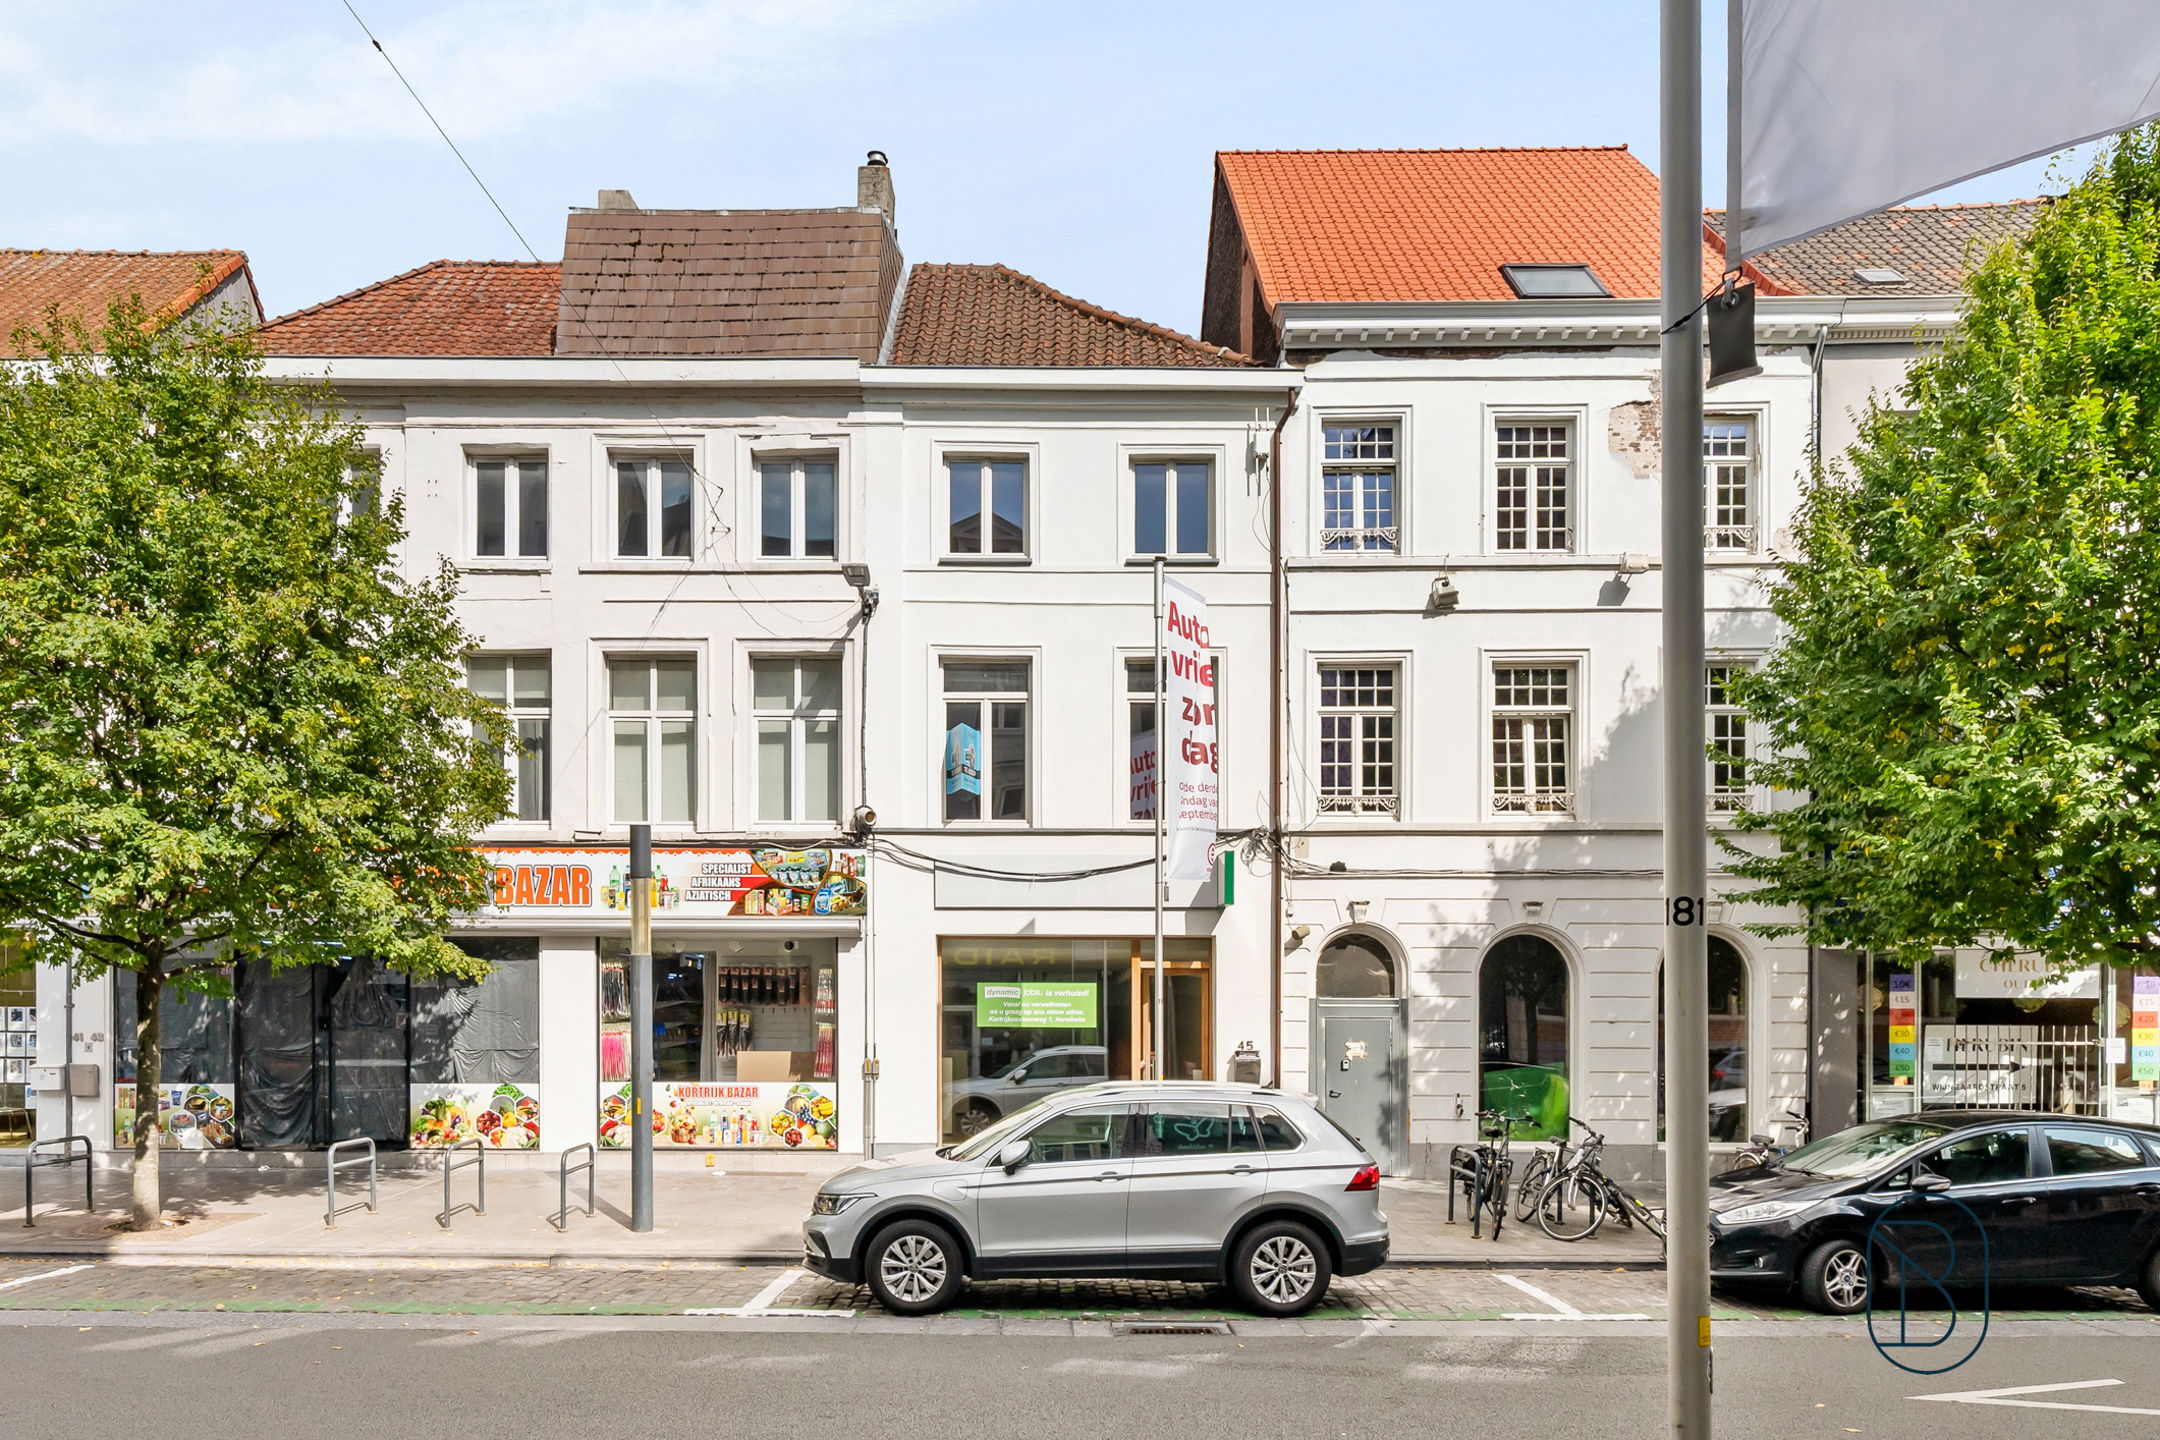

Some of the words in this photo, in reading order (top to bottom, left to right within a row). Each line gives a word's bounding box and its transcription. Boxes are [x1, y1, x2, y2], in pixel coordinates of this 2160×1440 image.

[1168, 601, 1209, 649] Auto
[1171, 650, 1213, 687] vrie
[1131, 750, 1155, 775] uto
[702, 863, 752, 875] SPECIALIST
[495, 866, 591, 906] BAZAR
[691, 877, 741, 888] AFRIKAANS
[685, 890, 731, 901] AZIATISCH
[1665, 896, 1704, 926] 181
[1980, 958, 2070, 973] CHERUB
[1894, 980, 1911, 989] 10€
[986, 988, 1019, 996] dynamic
[1054, 989, 1090, 997] verhuisd!
[1894, 995, 1910, 1003] €15
[2139, 1014, 2154, 1022] €20
[1895, 1030, 1910, 1038] €30
[1238, 1041, 1254, 1051] 45
[1895, 1047, 1910, 1055] €40
[1946, 1038, 2029, 1053] HERUBIN
[1895, 1064, 1910, 1072] €50
[2139, 1067, 2154, 1075] €50
[678, 1086, 725, 1098] KORTRIJK
[727, 1086, 758, 1098] BAZAR
[2021, 1083, 2027, 1091] 5
